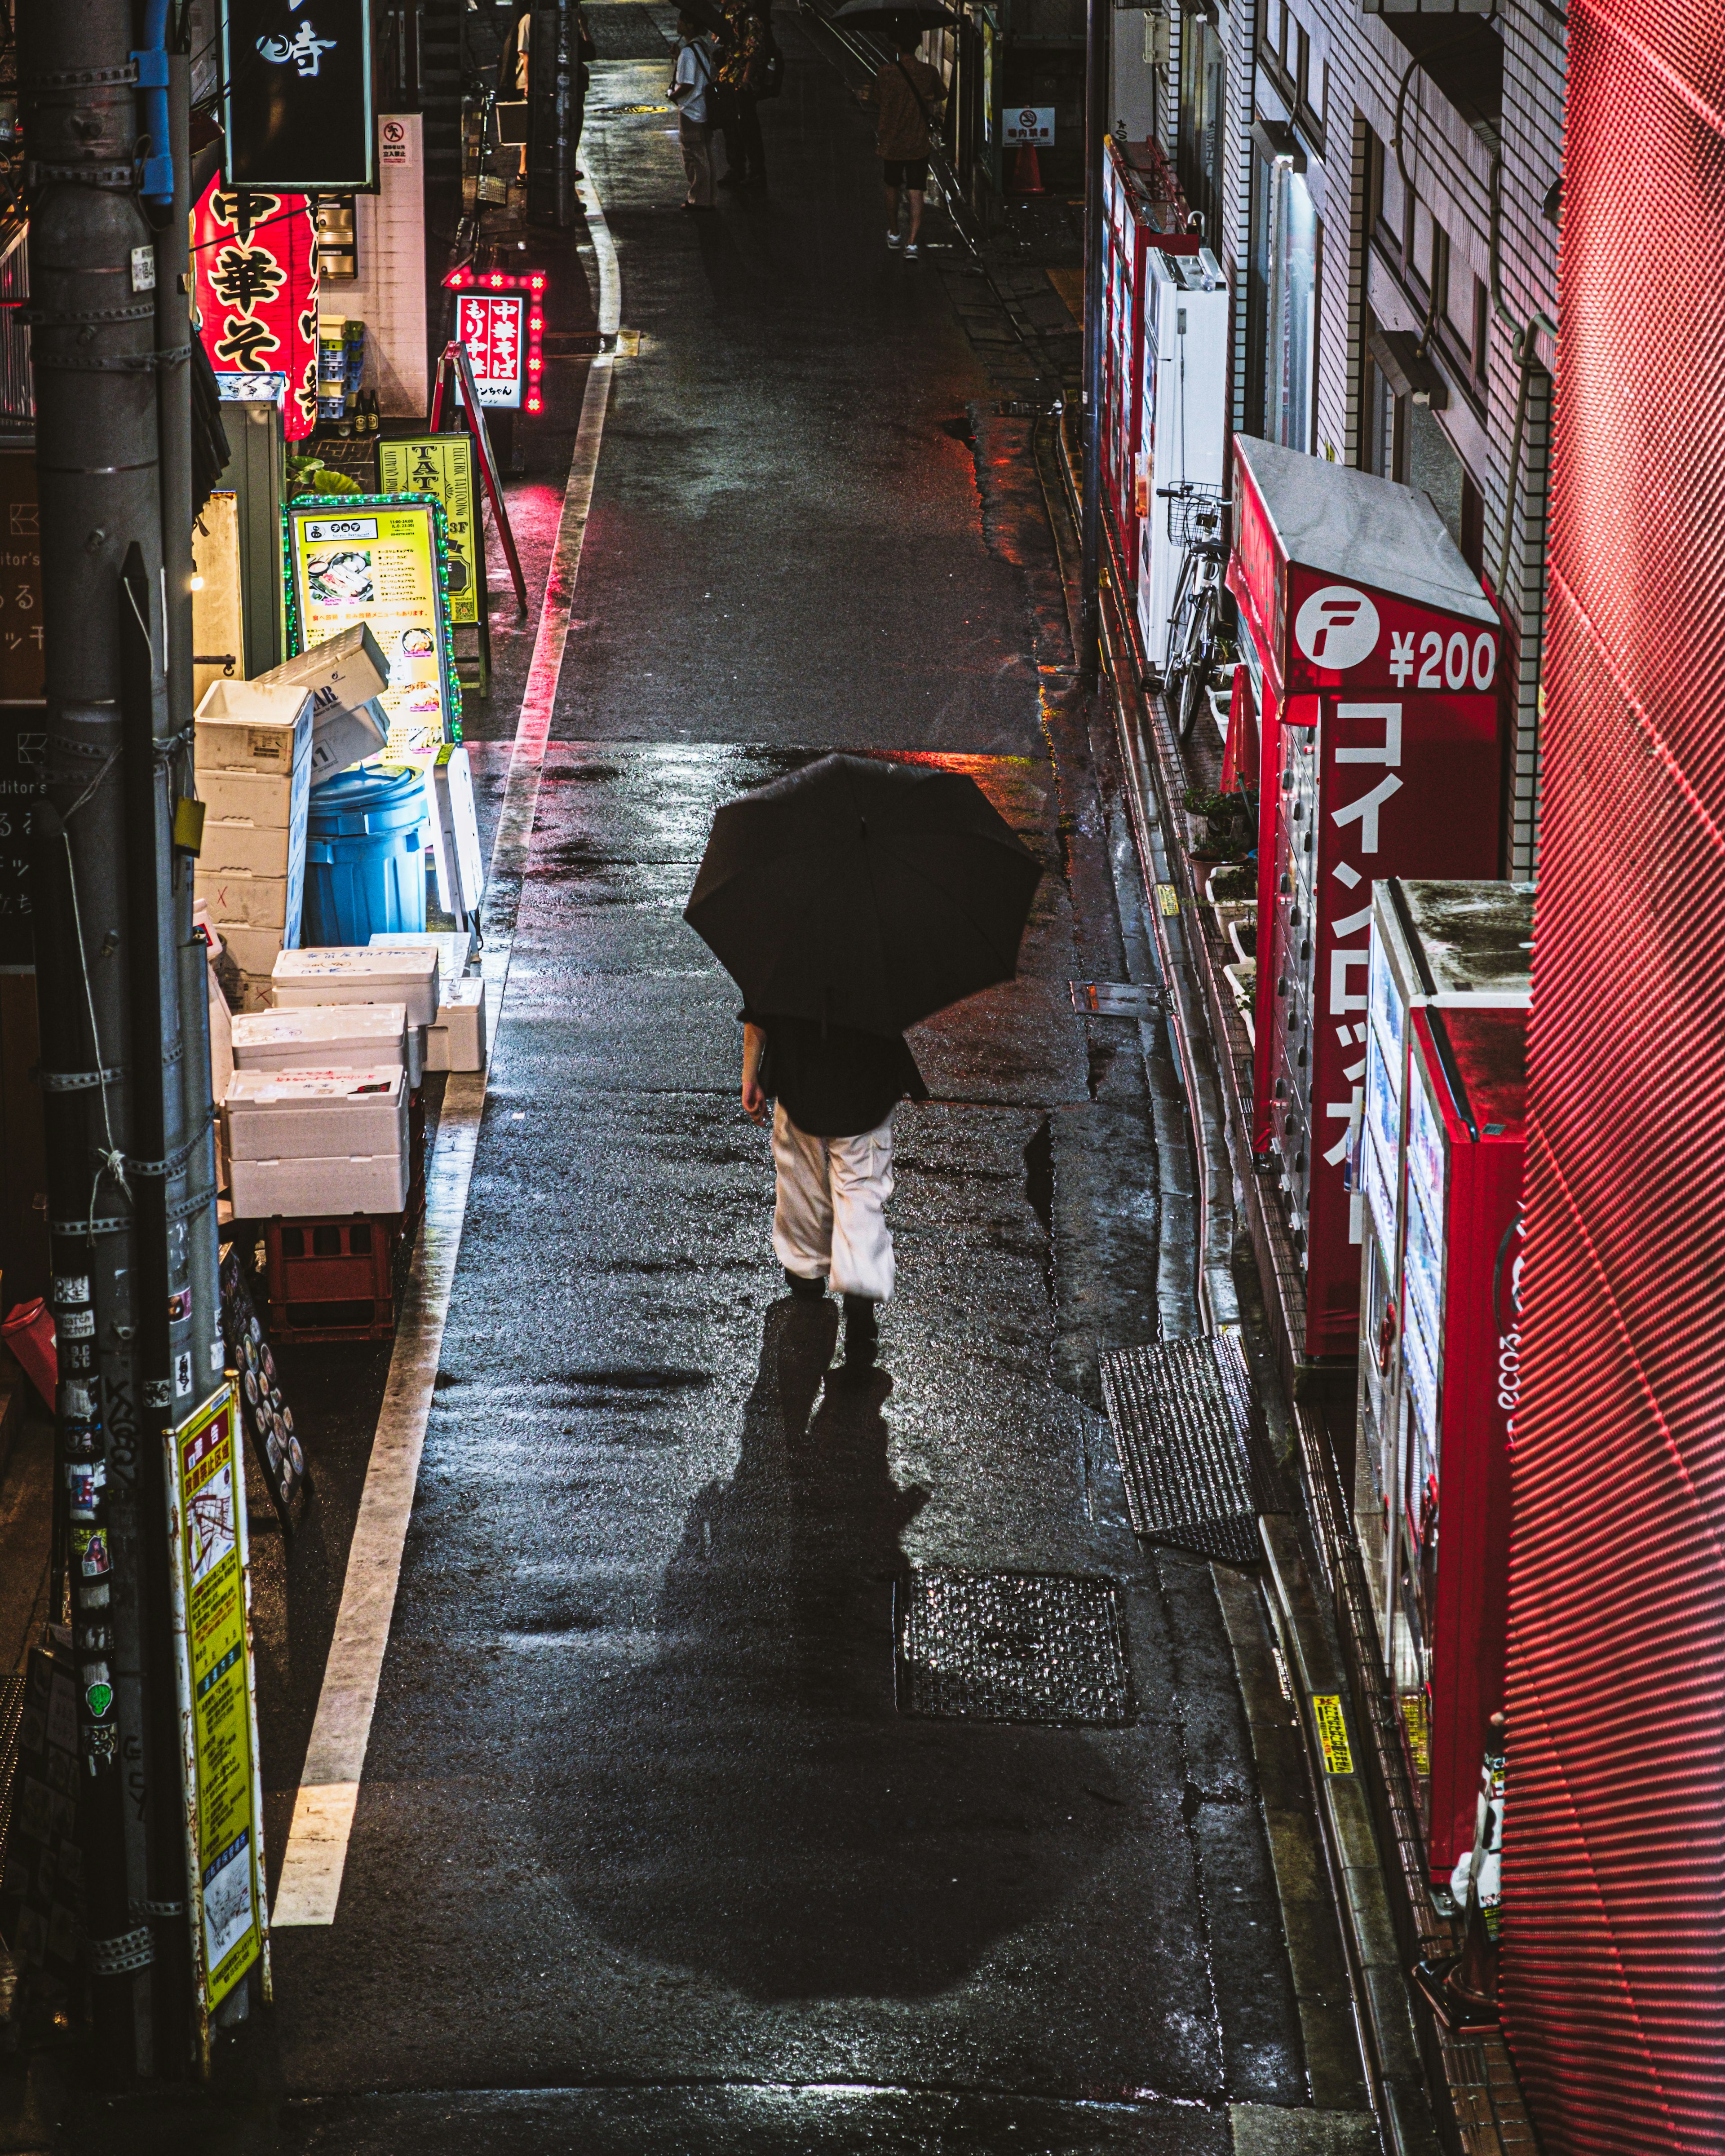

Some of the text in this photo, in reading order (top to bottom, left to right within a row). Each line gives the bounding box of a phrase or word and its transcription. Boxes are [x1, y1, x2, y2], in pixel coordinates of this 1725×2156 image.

[256, 0, 337, 77] 崎
[491, 300, 518, 378] 中華そば
[477, 386, 512, 396] ンちゃん
[384, 451, 398, 477] QUALITY
[411, 446, 439, 497] TAT
[453, 447, 469, 517] ELECTRIC TATTOOING
[331, 522, 361, 533] チョデ
[449, 521, 469, 534] 3F
[1390, 630, 1496, 691] ¥200
[314, 685, 339, 711] AR
[185, 1440, 230, 1498] 放置禁止区域
